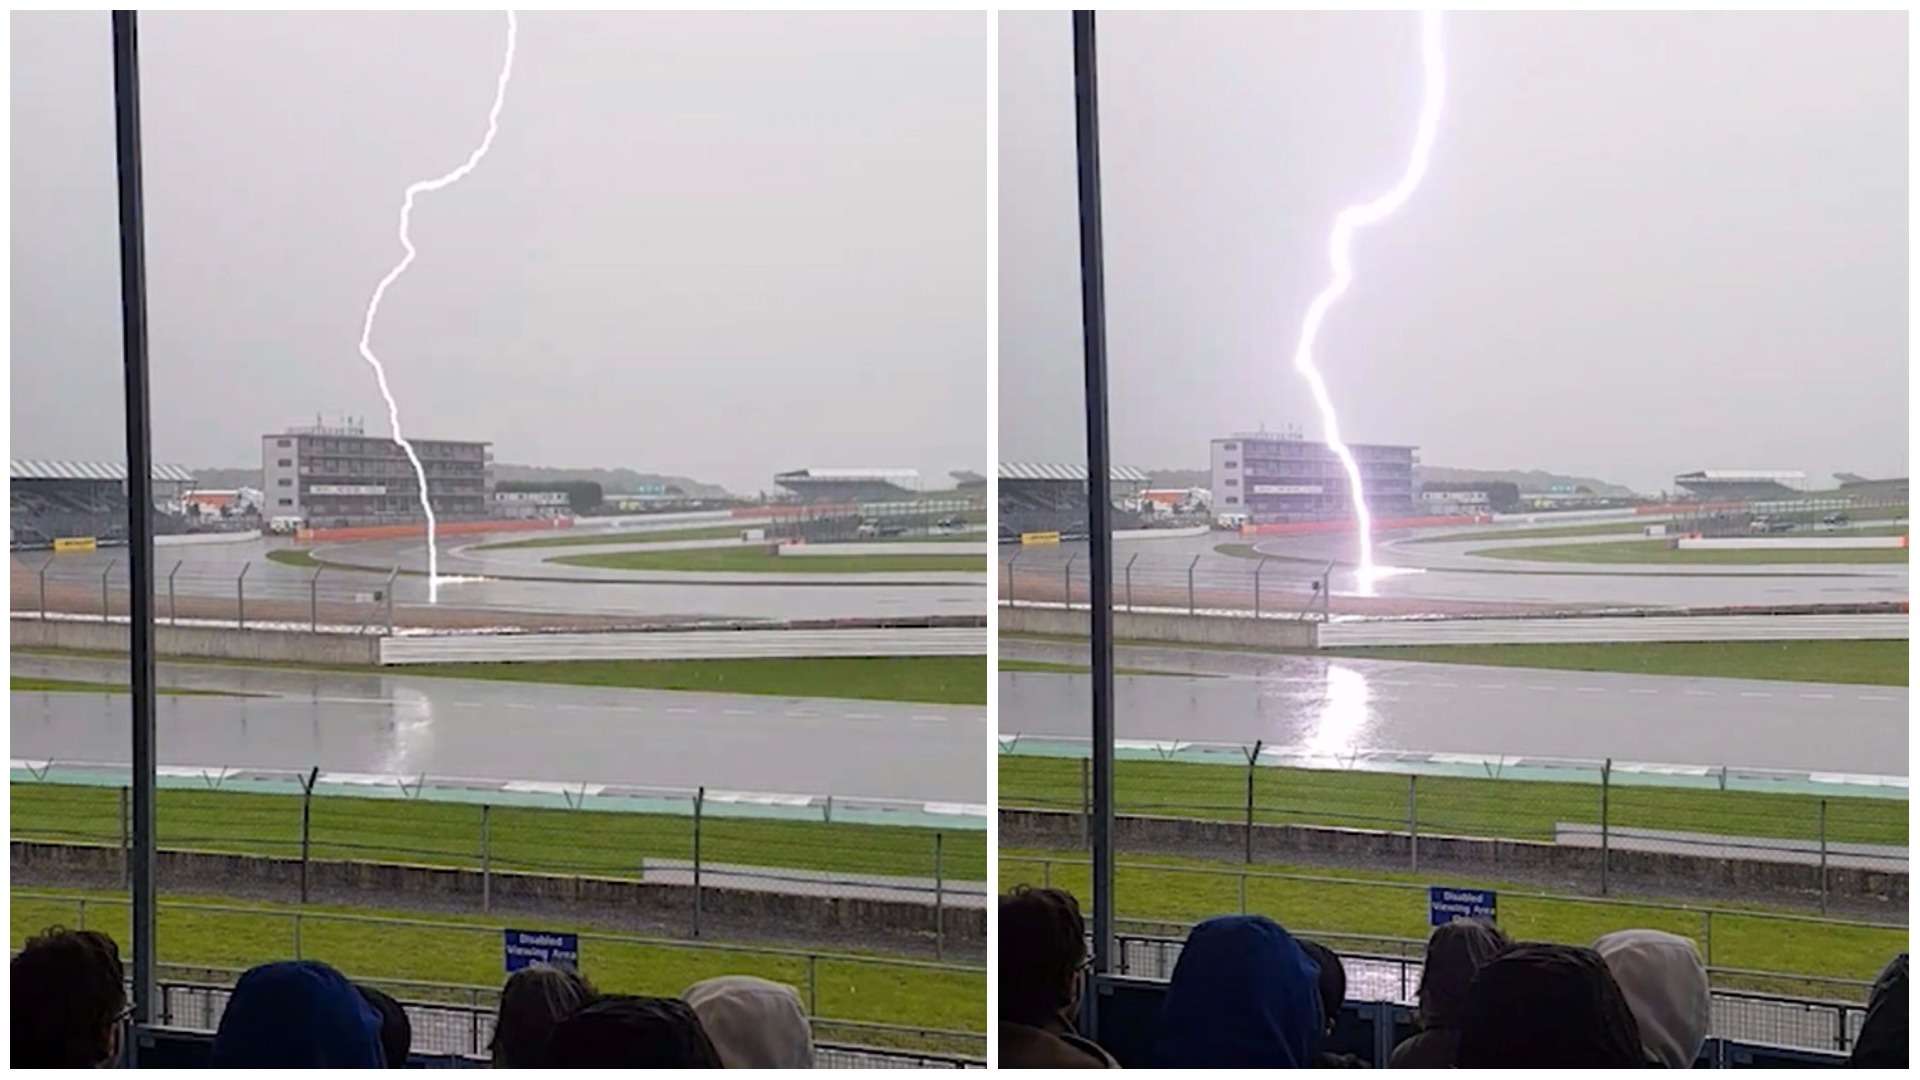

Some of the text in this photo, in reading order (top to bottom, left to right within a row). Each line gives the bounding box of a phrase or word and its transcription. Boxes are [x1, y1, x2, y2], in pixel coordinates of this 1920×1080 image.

[1443, 891, 1483, 903] Disabled
[1431, 902, 1496, 915] Viewing Area
[519, 933, 563, 946] Disabled
[506, 945, 577, 960] Viewing Area
